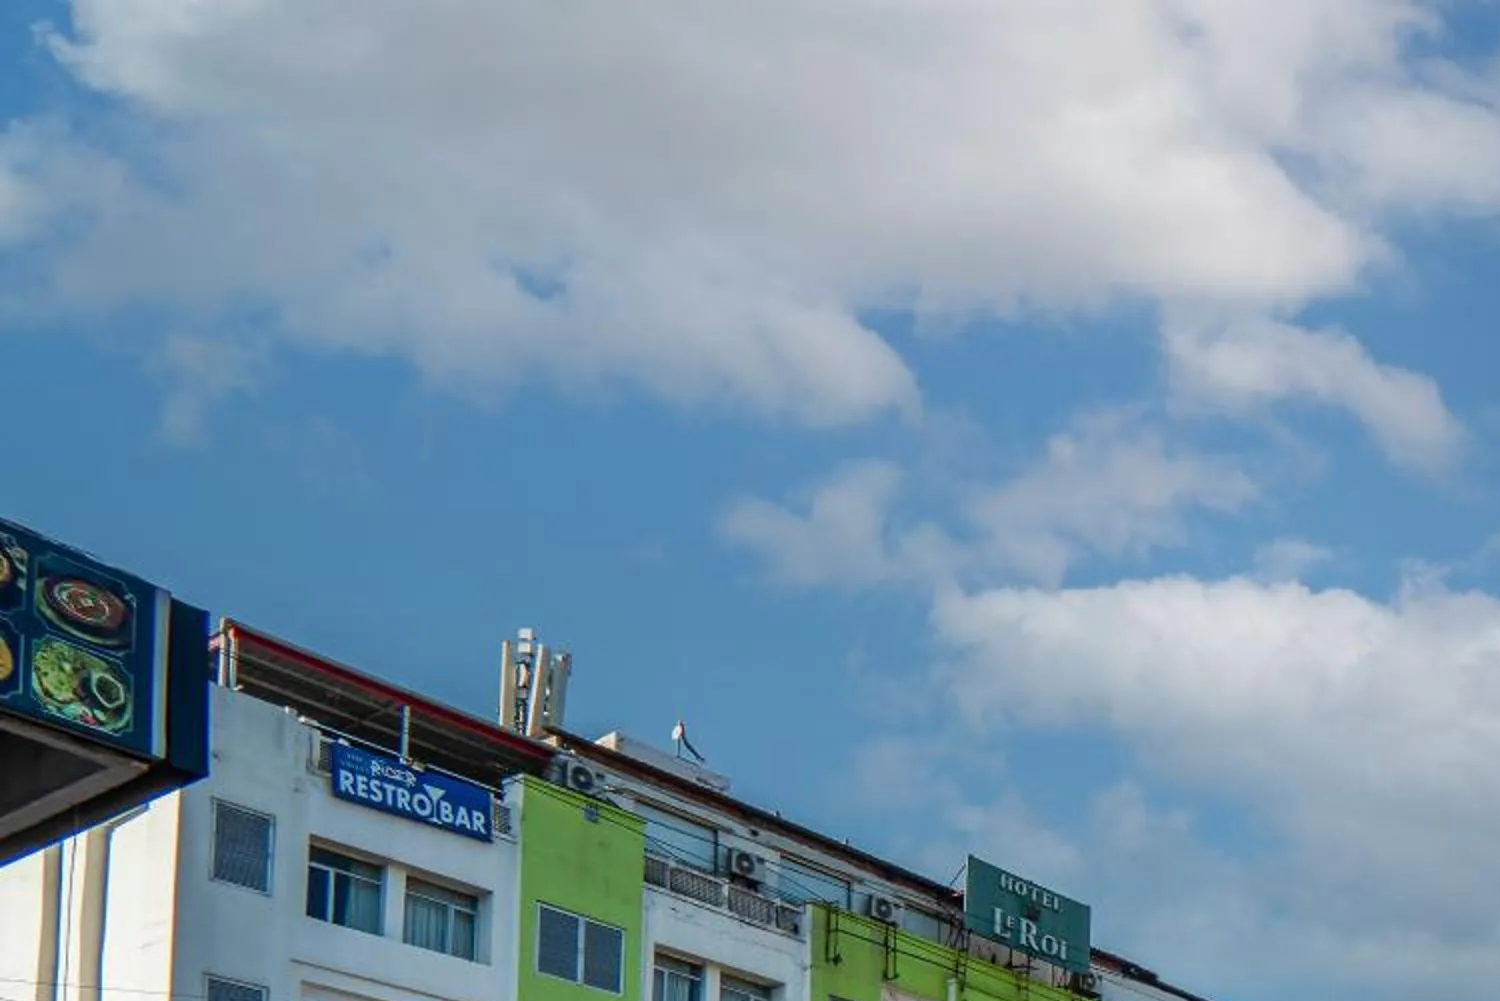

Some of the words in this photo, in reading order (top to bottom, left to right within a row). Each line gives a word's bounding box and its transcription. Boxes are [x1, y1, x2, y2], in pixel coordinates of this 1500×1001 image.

[339, 769, 432, 816] RESTRO
[438, 800, 487, 834] BAR
[1001, 874, 1062, 912] HOTEL
